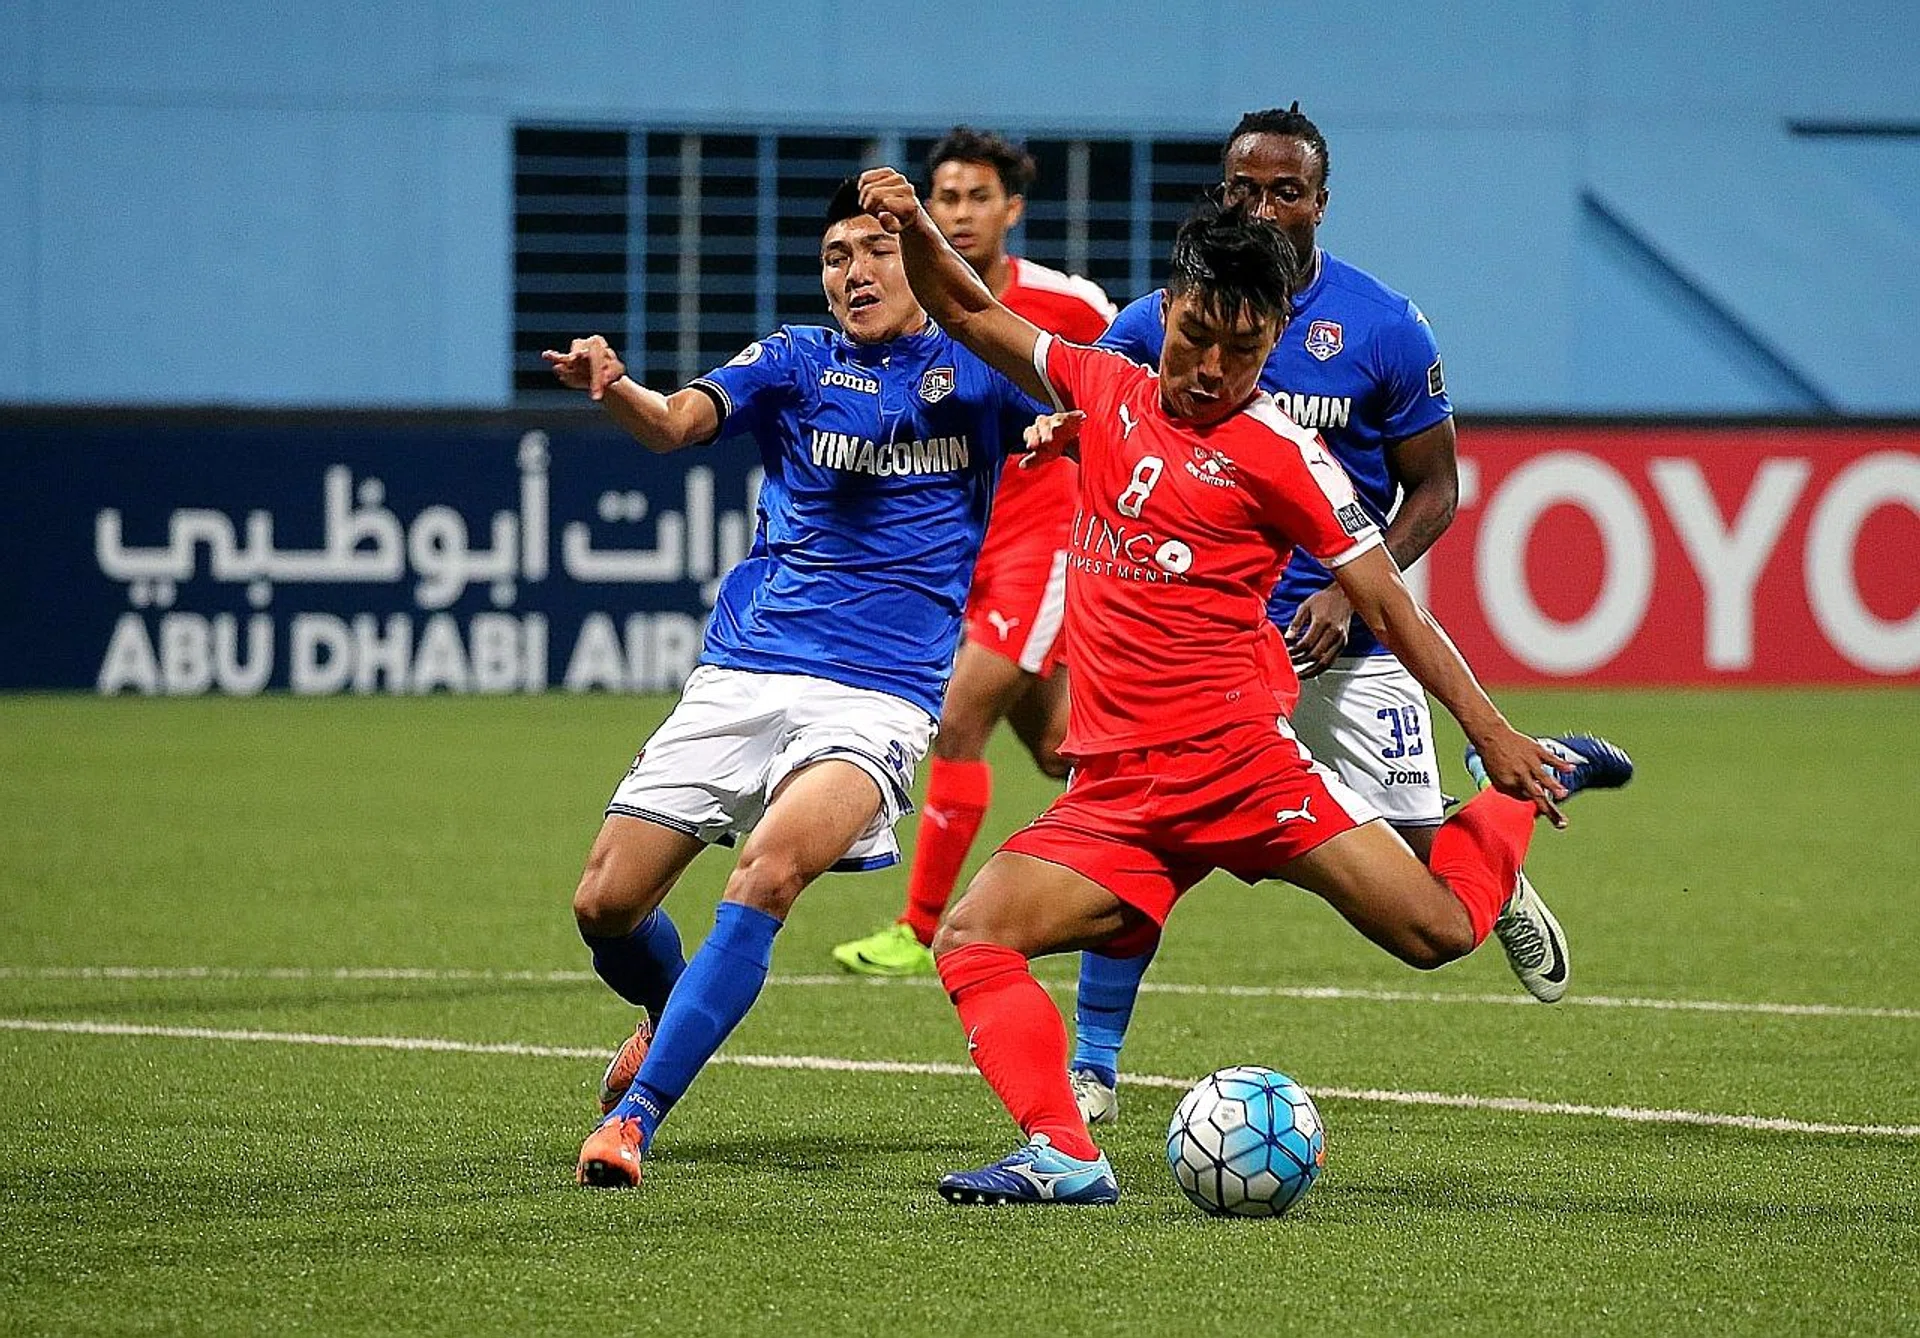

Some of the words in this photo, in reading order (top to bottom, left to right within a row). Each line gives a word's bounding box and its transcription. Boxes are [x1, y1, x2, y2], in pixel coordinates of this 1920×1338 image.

[1264, 392, 1351, 428] OMIN
[811, 429, 969, 476] VINACOMIN
[1117, 455, 1164, 518] 8
[95, 430, 549, 608] أبوظبي
[1068, 551, 1189, 584] IVESTMENT
[97, 612, 275, 694] ABU
[290, 612, 549, 694] DHABI
[562, 612, 704, 694] AIR
[1376, 705, 1423, 759] 39
